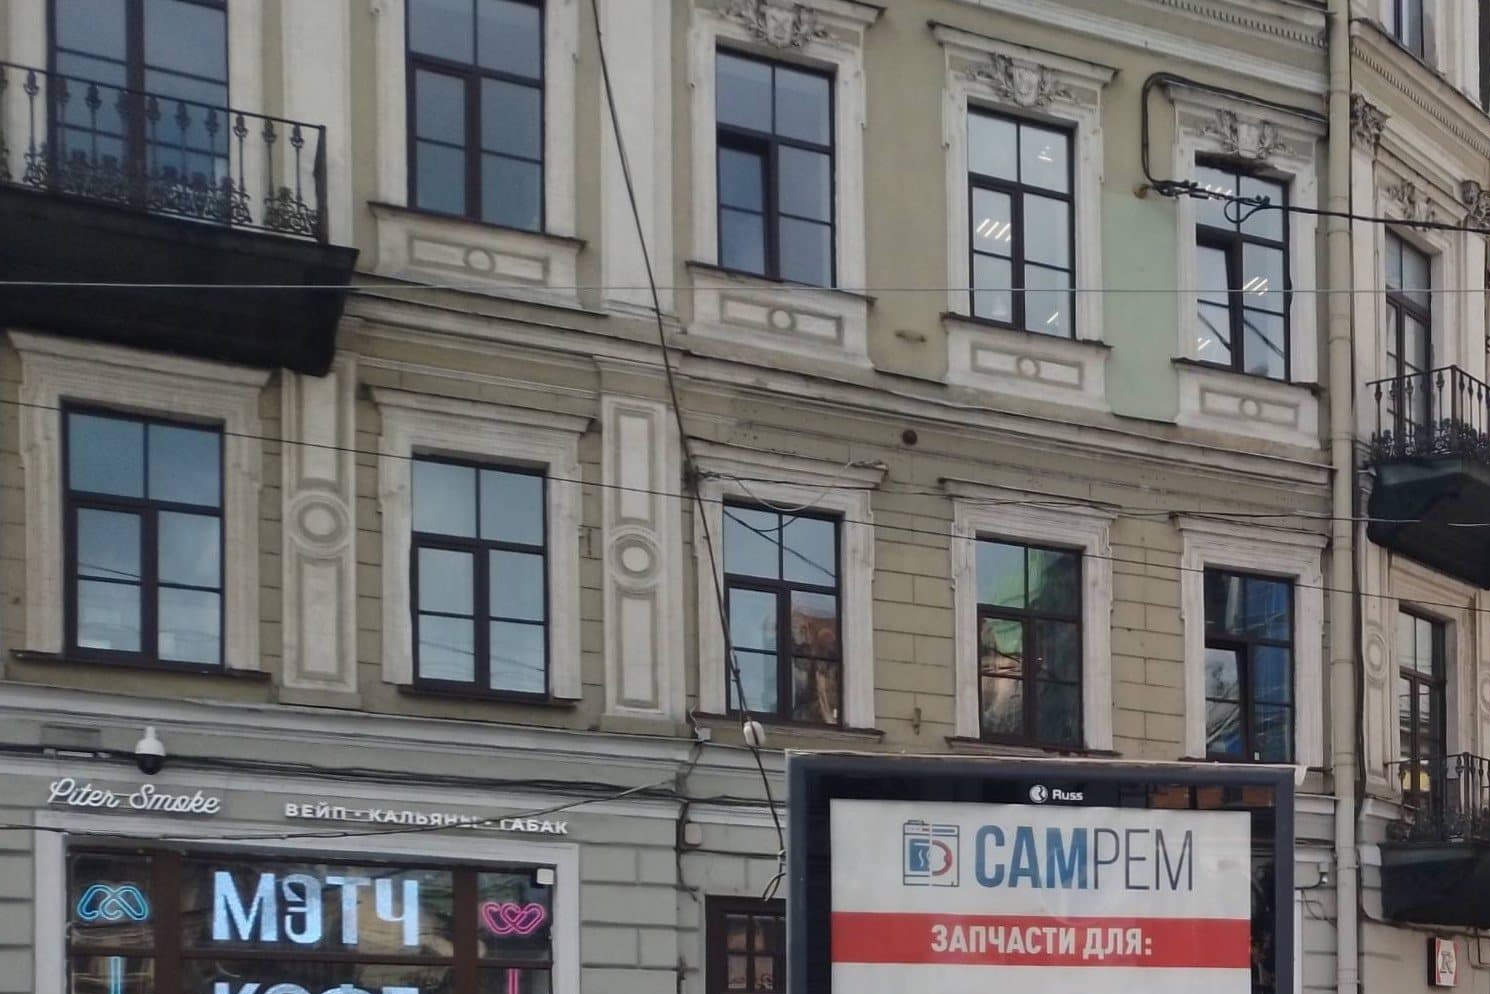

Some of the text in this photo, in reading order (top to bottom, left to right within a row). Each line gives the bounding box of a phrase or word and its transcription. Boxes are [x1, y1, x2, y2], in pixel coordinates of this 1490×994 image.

[48, 777, 221, 814] Piter Smoke
[285, 800, 347, 819] ВЕЙП
[1051, 788, 1084, 801] Russ
[974, 824, 1194, 891] САМРЕМ
[930, 924, 1153, 959] ЗАПЧАСТИ ДЛЯ:
